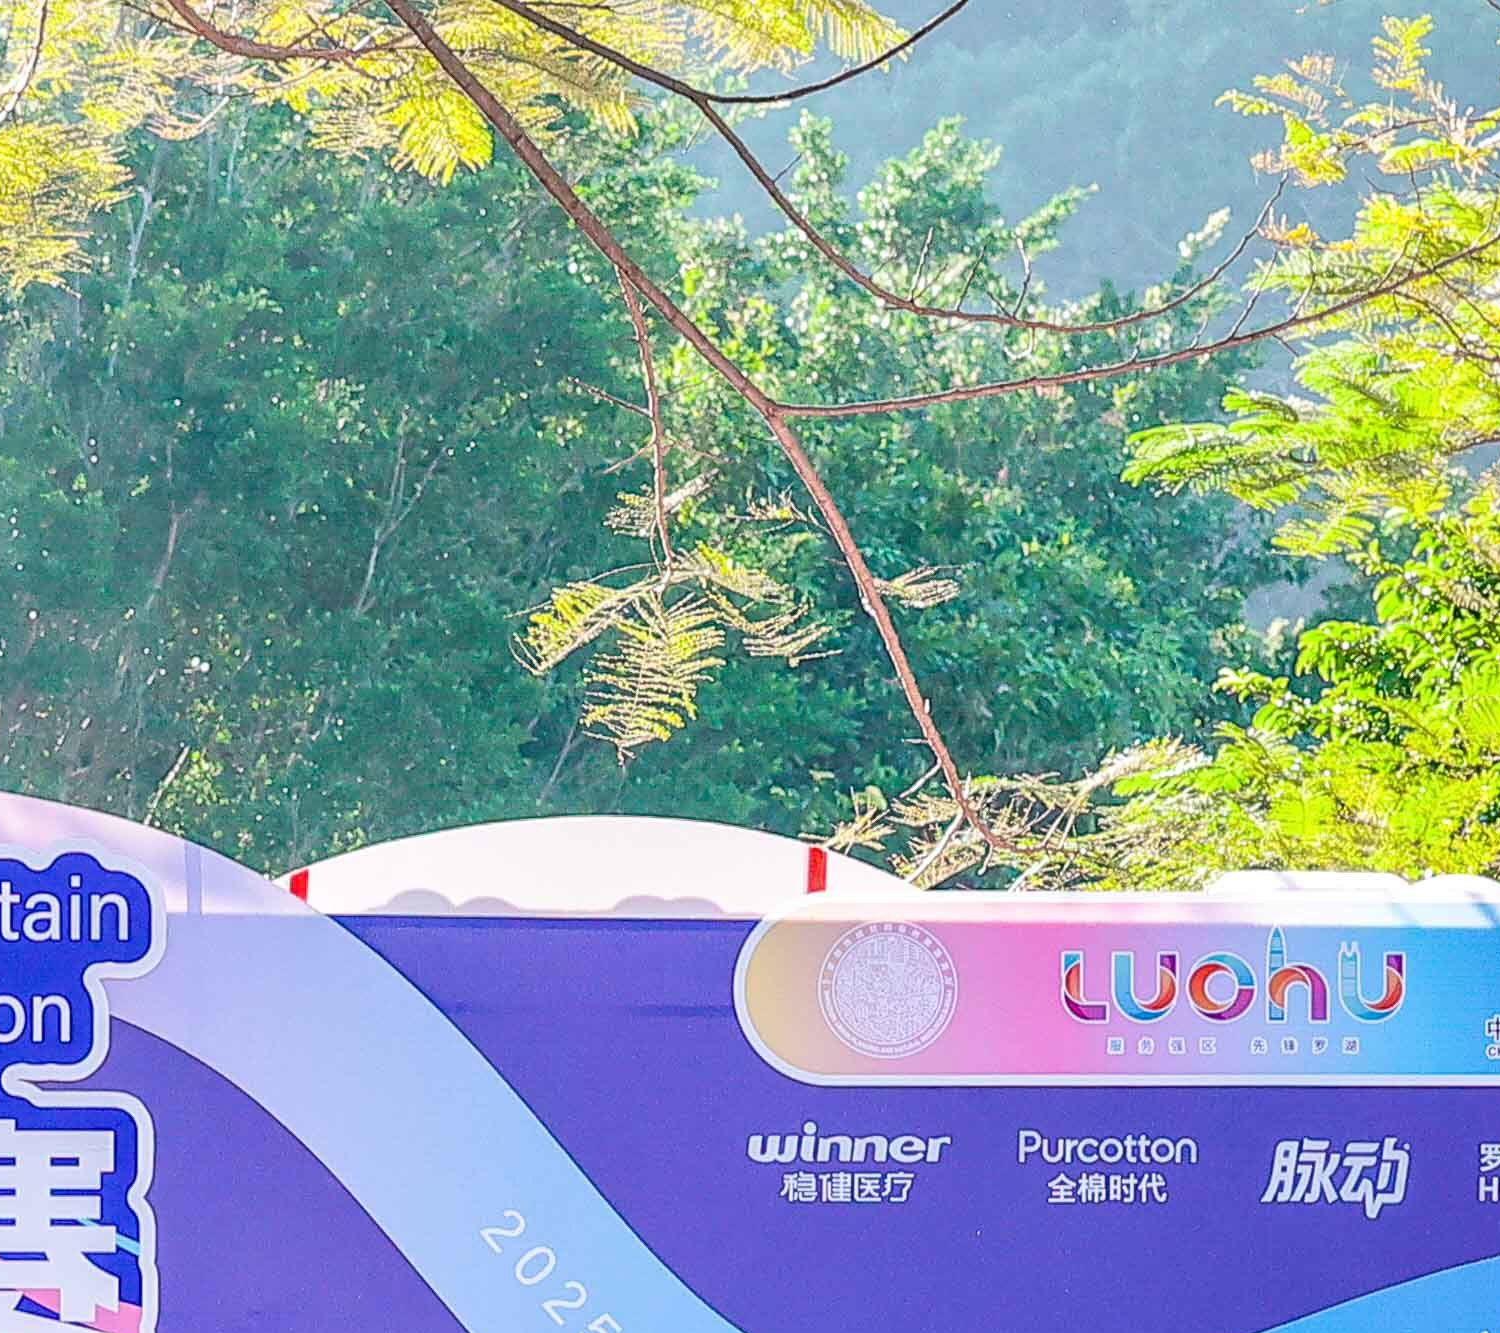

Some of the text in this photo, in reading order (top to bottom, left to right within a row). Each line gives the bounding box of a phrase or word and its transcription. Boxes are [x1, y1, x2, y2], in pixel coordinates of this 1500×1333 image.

[748, 1121, 952, 1163] winner
[1017, 1130, 1198, 1164] Purcotton
[780, 1173, 915, 1203] 稳健医疗
[1047, 1173, 1168, 1204] 全棉时代
[1260, 1137, 1411, 1219] 脉动
